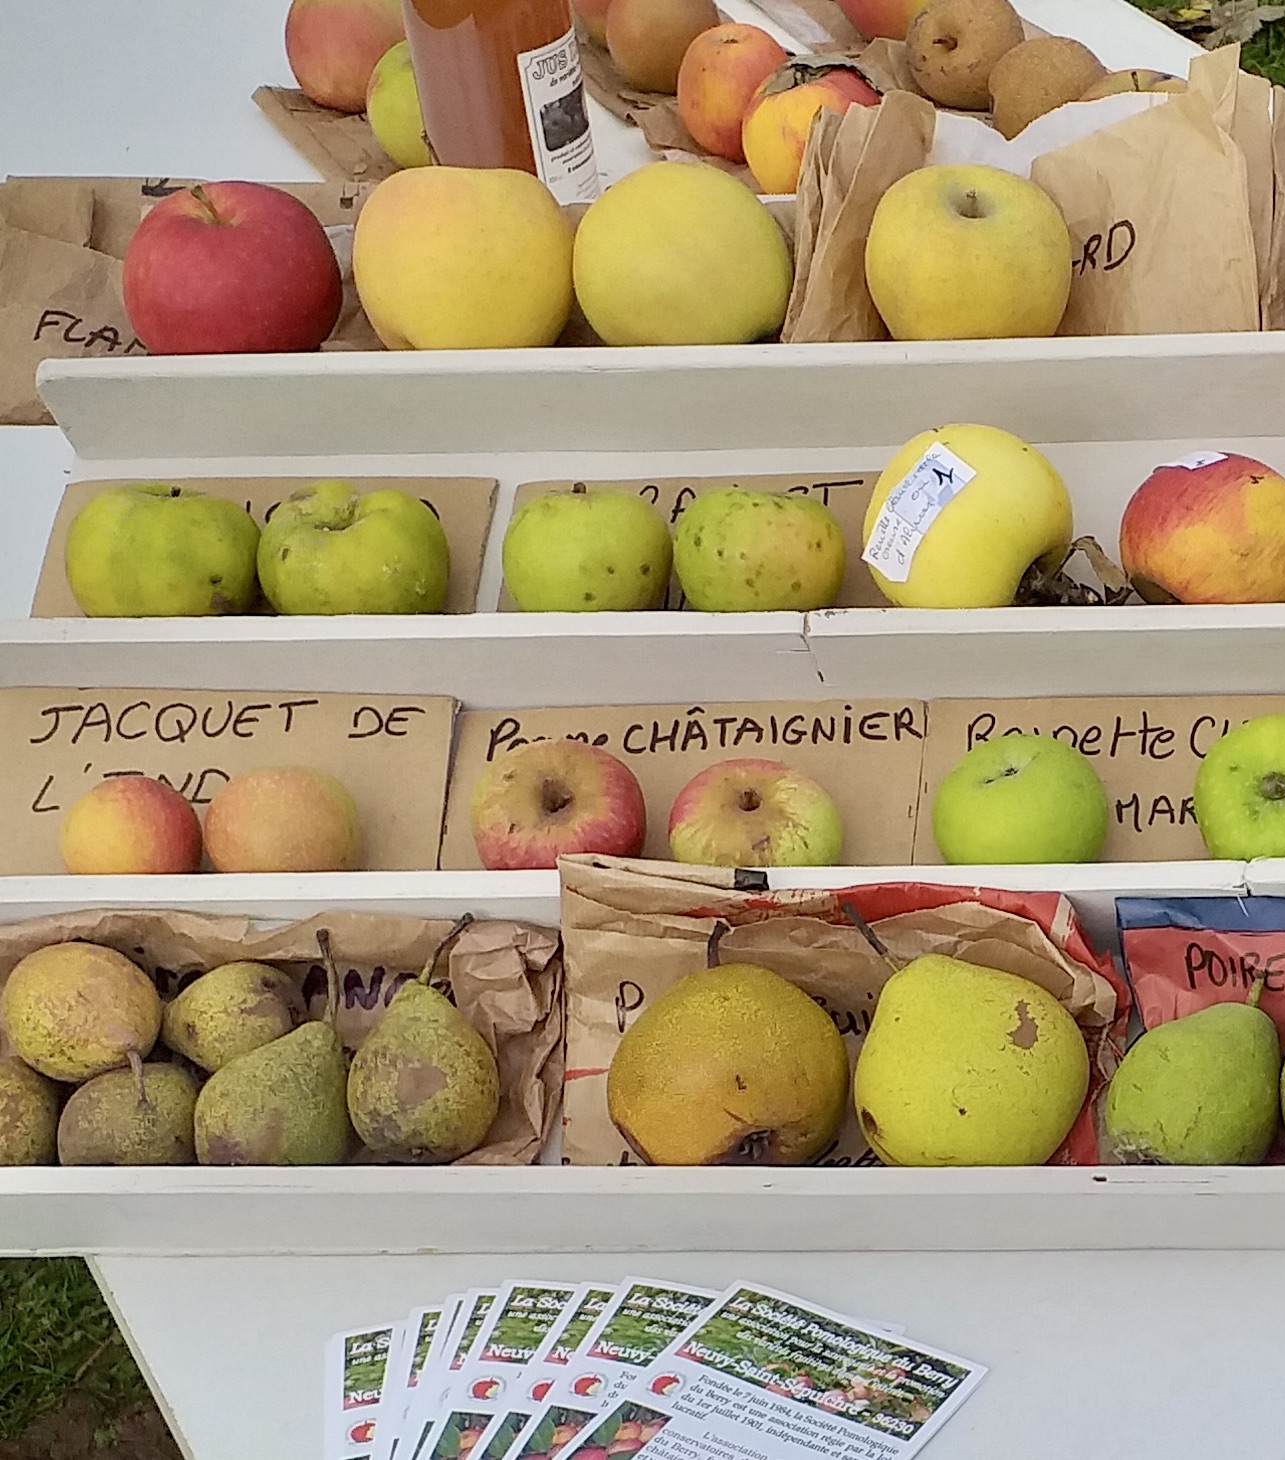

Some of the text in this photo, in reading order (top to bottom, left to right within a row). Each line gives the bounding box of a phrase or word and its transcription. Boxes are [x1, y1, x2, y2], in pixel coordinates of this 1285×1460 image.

[532, 49, 568, 80] JUS
[932, 467, 954, 487] 1
[29, 699, 427, 744] JACQUET DE
[511, 1294, 536, 1308] La
[626, 1292, 655, 1306] La
[728, 1296, 960, 1390] La Société Pomologique du Berry
[683, 1340, 860, 1416] Neuvy-Saint-Sépulchre
[871, 1413, 915, 1435] 36230
[894, 1374, 946, 1398] promotion
[671, 1400, 709, 1422] lucratif.
[680, 1392, 697, 1404] du
[696, 1397, 713, 1410] 1er
[709, 1404, 741, 1422] juillet
[765, 1425, 831, 1455] indépendante
[689, 1383, 705, 1395] du
[704, 1389, 733, 1406] Berry
[732, 1400, 748, 1412] est
[748, 1407, 768, 1420] une
[768, 1415, 820, 1439] association
[820, 1431, 846, 1448] régie
[844, 1444, 865, 1455] par
[698, 1374, 733, 1394] Fondée
[732, 1387, 742, 1398] le
[746, 1394, 769, 1409] juin
[802, 1414, 838, 1434] Société
[836, 1426, 900, 1456] Pomologique
[653, 1435, 669, 1447] du
[661, 1428, 736, 1460] conservatoires
